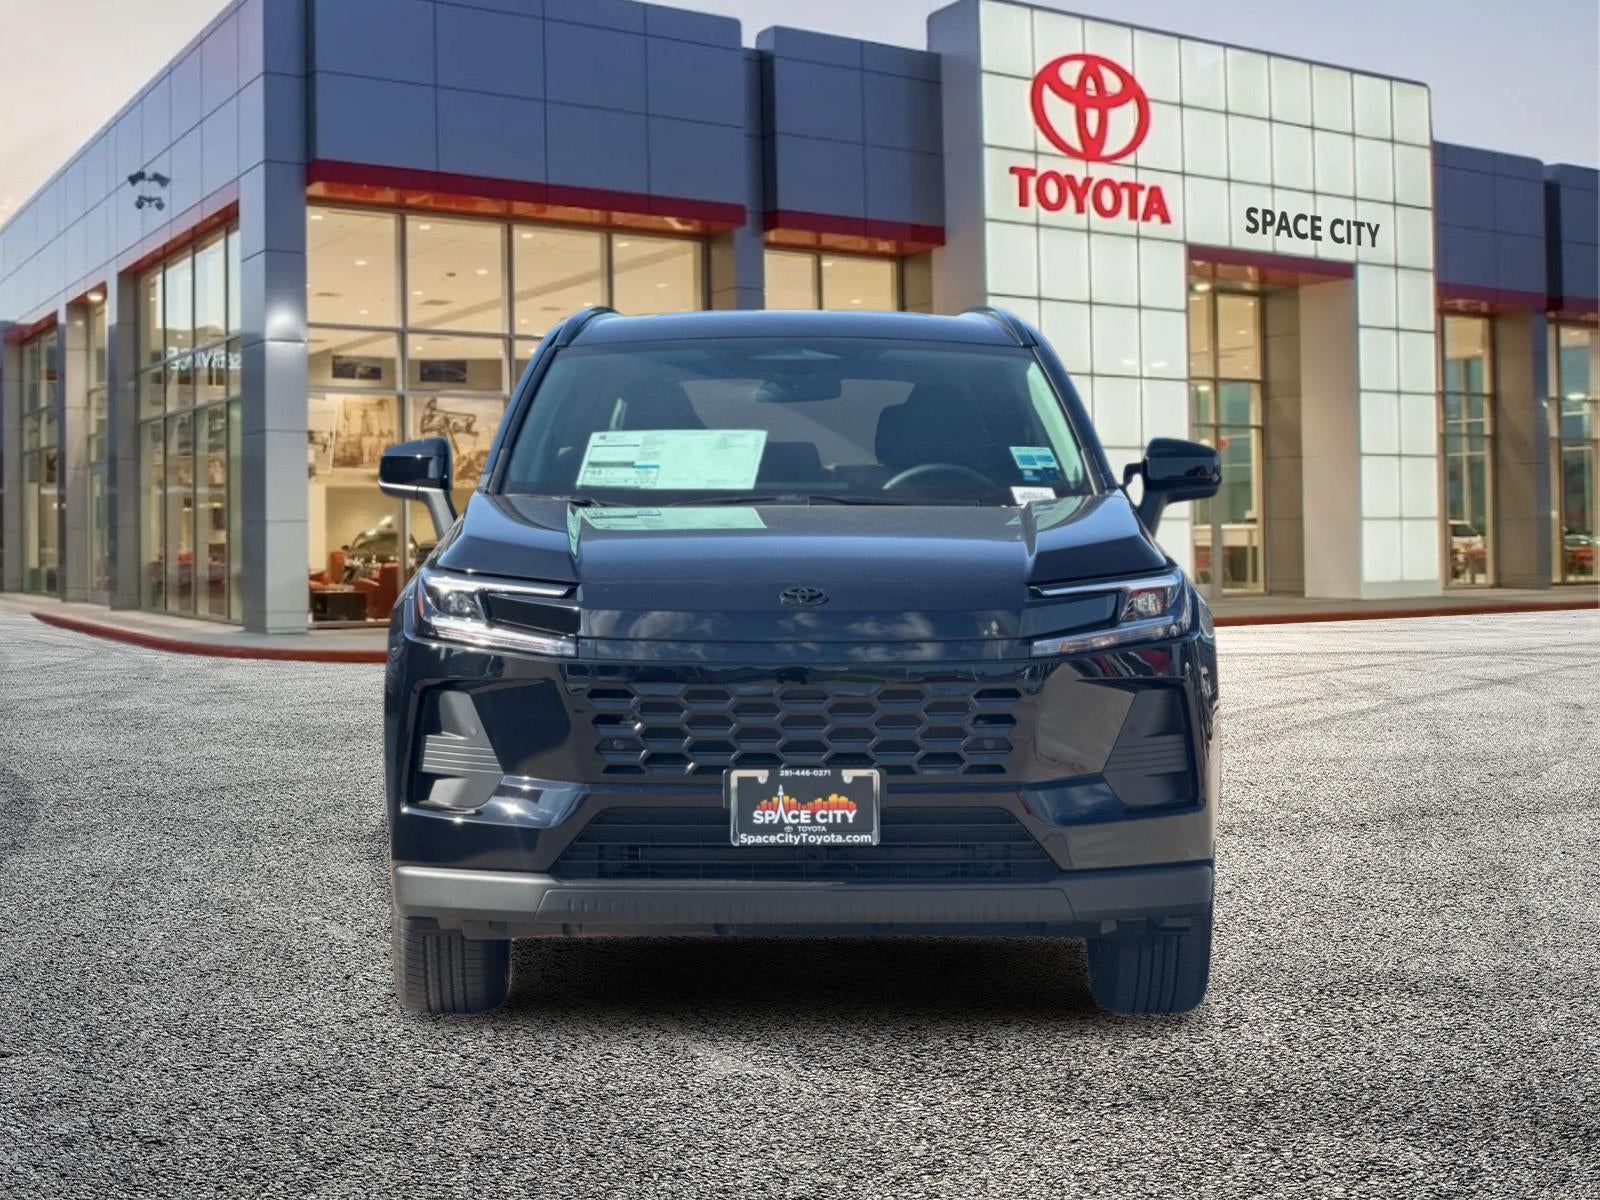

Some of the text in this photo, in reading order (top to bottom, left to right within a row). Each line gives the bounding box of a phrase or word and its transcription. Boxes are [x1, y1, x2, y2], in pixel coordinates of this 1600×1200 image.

[1009, 165, 1171, 224] TOYOTA
[1245, 206, 1381, 248] SPACE CITY
[752, 809, 857, 824] SPACE CITY
[739, 833, 872, 846] SpaceCityToyota.com
